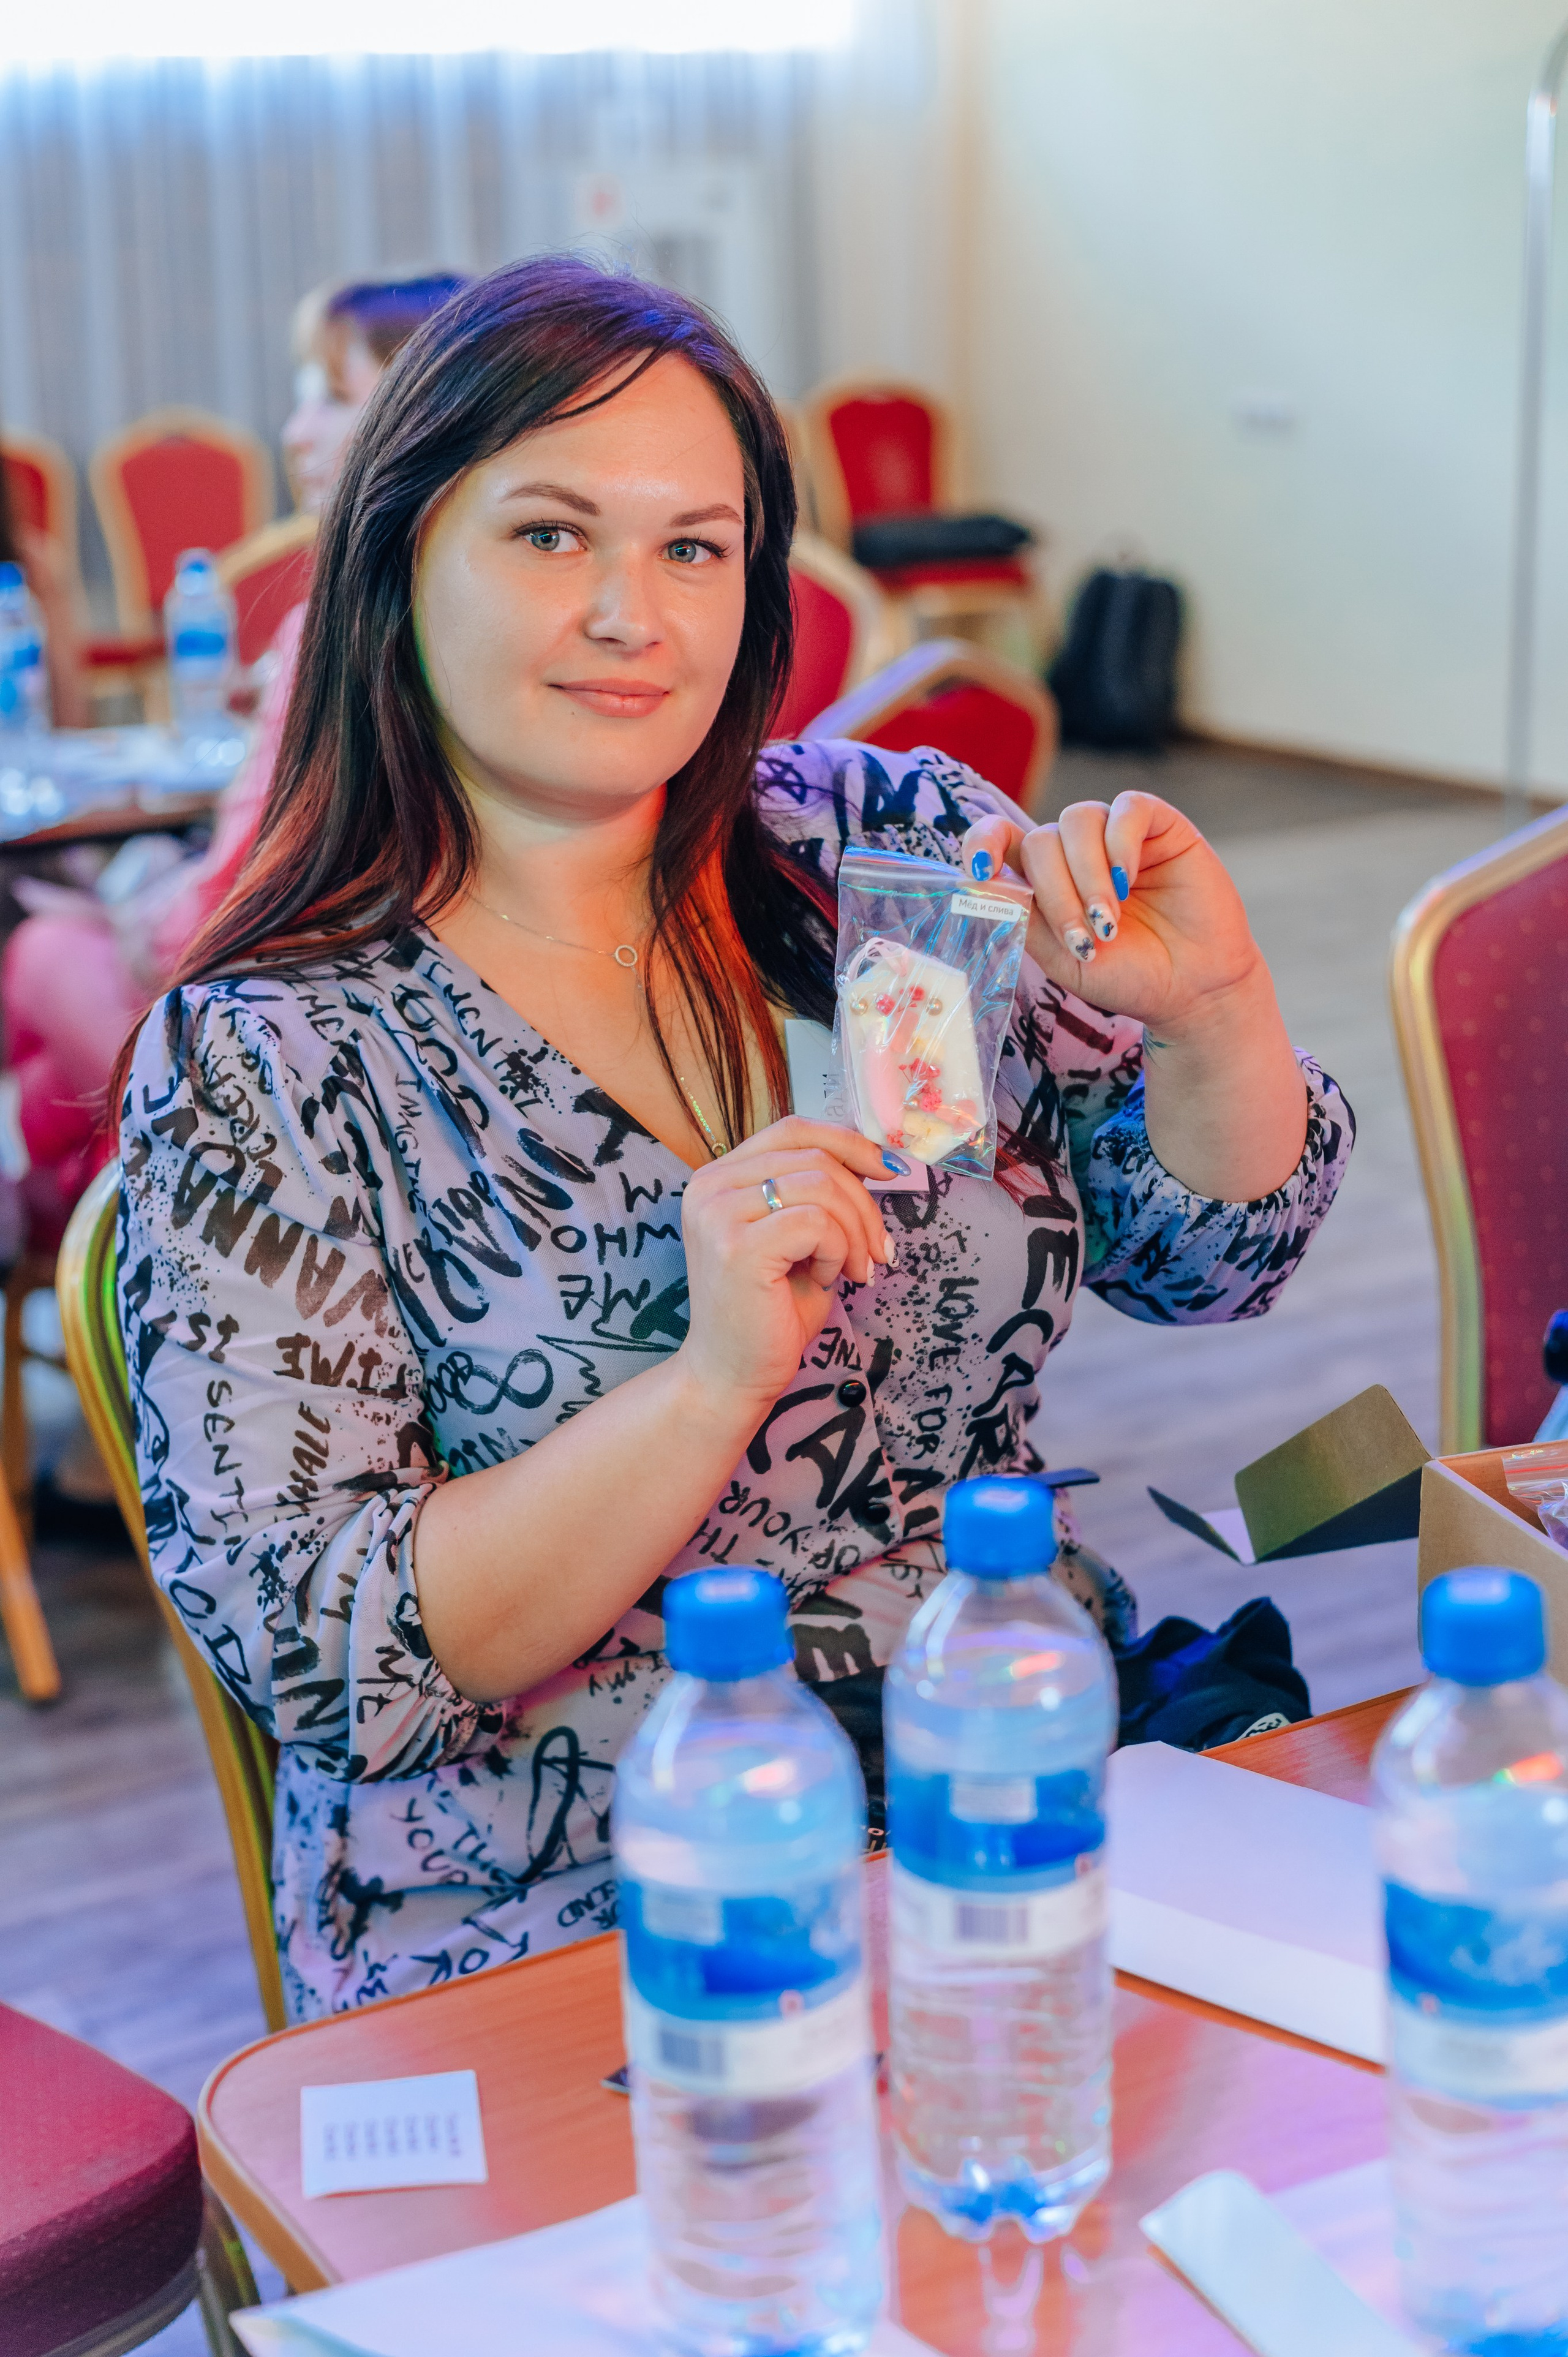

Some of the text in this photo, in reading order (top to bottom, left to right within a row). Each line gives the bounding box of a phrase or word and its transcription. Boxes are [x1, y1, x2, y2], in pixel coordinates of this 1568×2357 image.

[988, 905, 1013, 916] слива
[929, 1276, 979, 1373] LOVE
[916, 1384, 952, 1458] FOR
